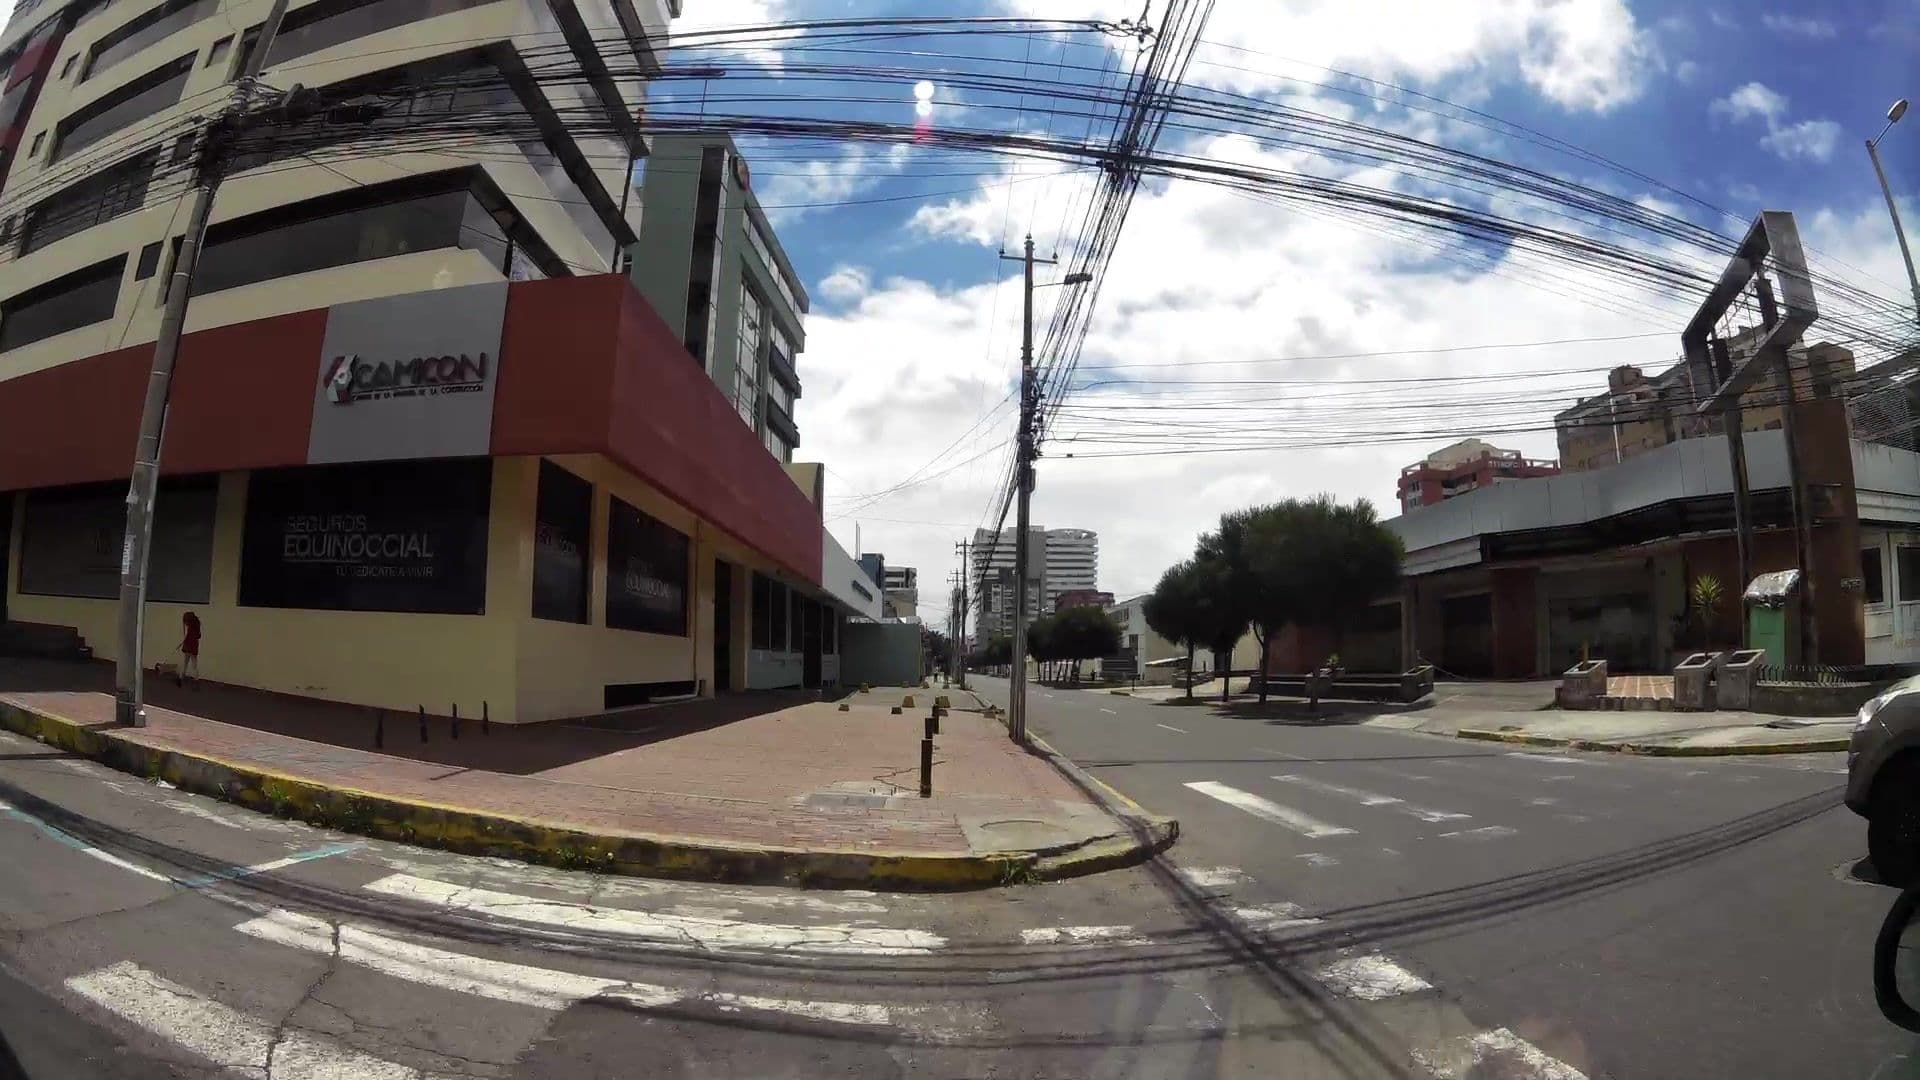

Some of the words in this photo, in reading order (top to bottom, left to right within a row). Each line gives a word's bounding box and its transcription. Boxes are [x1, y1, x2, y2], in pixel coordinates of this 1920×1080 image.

[357, 352, 487, 386] CAMICON
[288, 515, 367, 532] SEGUROS
[283, 533, 433, 558] EQUINOCCIAL
